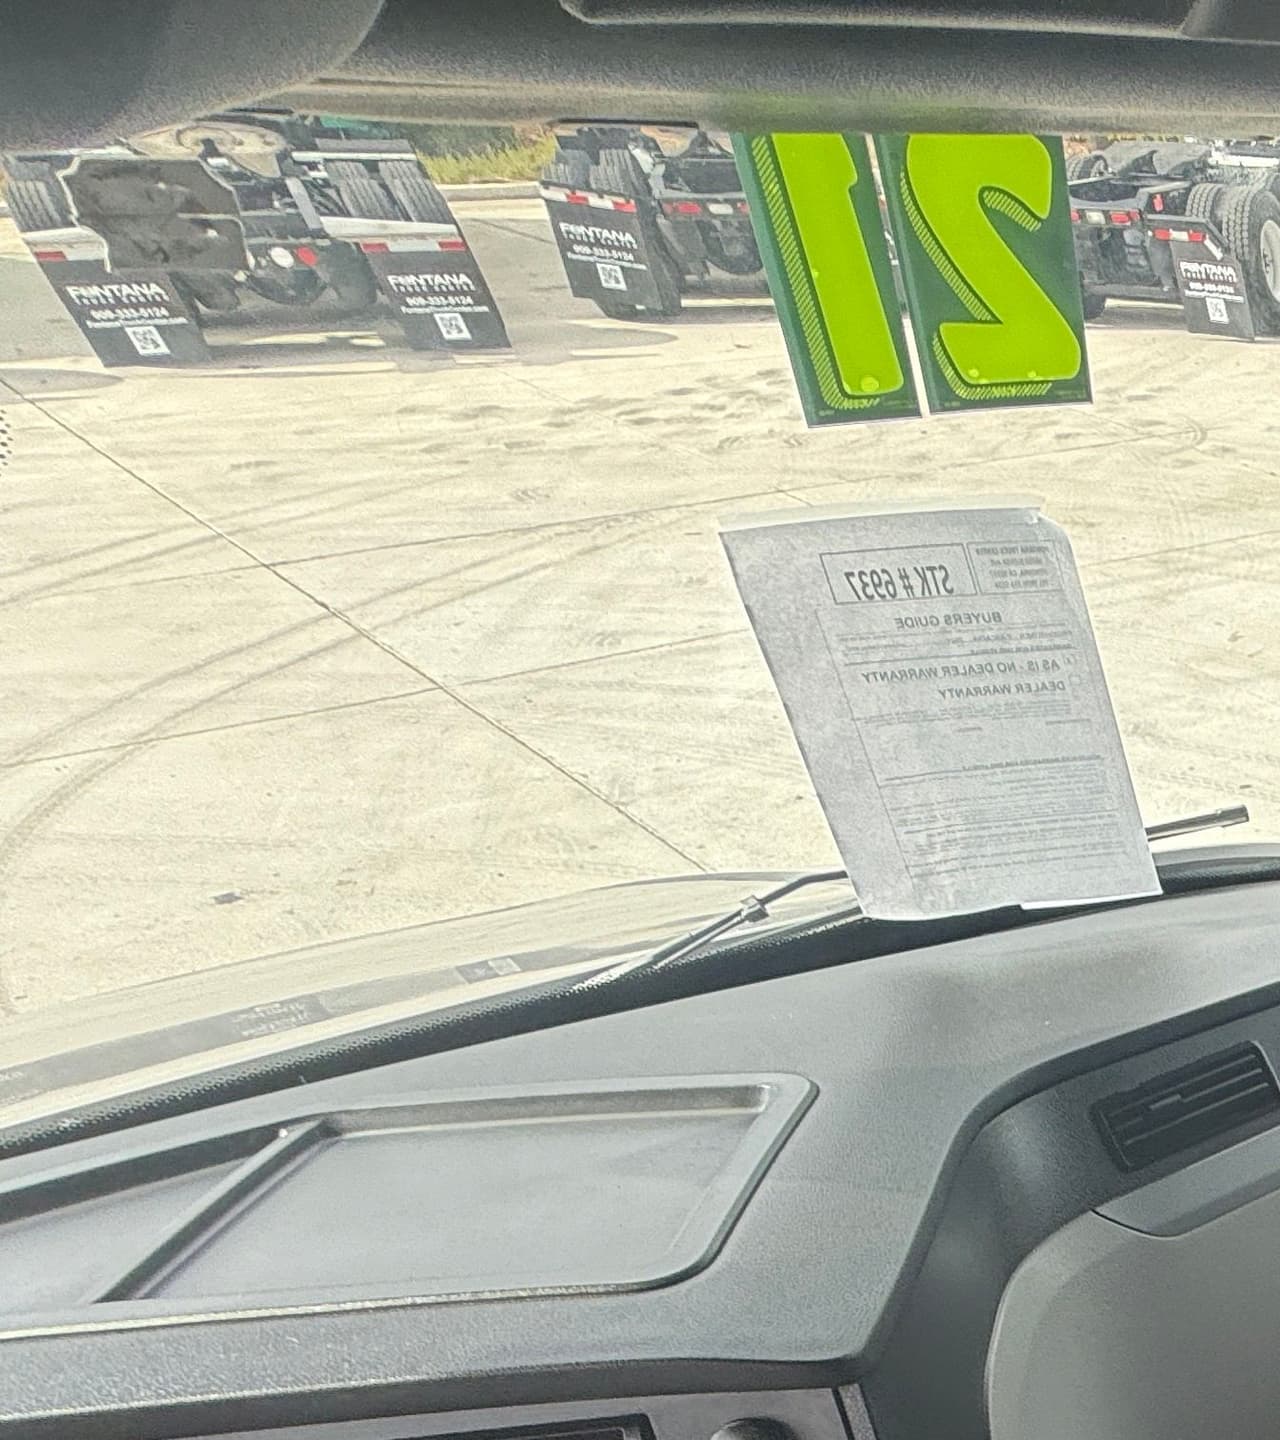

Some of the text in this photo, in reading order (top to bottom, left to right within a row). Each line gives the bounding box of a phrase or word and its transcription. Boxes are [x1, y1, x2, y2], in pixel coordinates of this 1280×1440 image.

[559, 222, 637, 243] FONTANA
[1180, 262, 1237, 278] FONTANA
[387, 273, 475, 289] FONTANA
[65, 283, 167, 300] FONTANA
